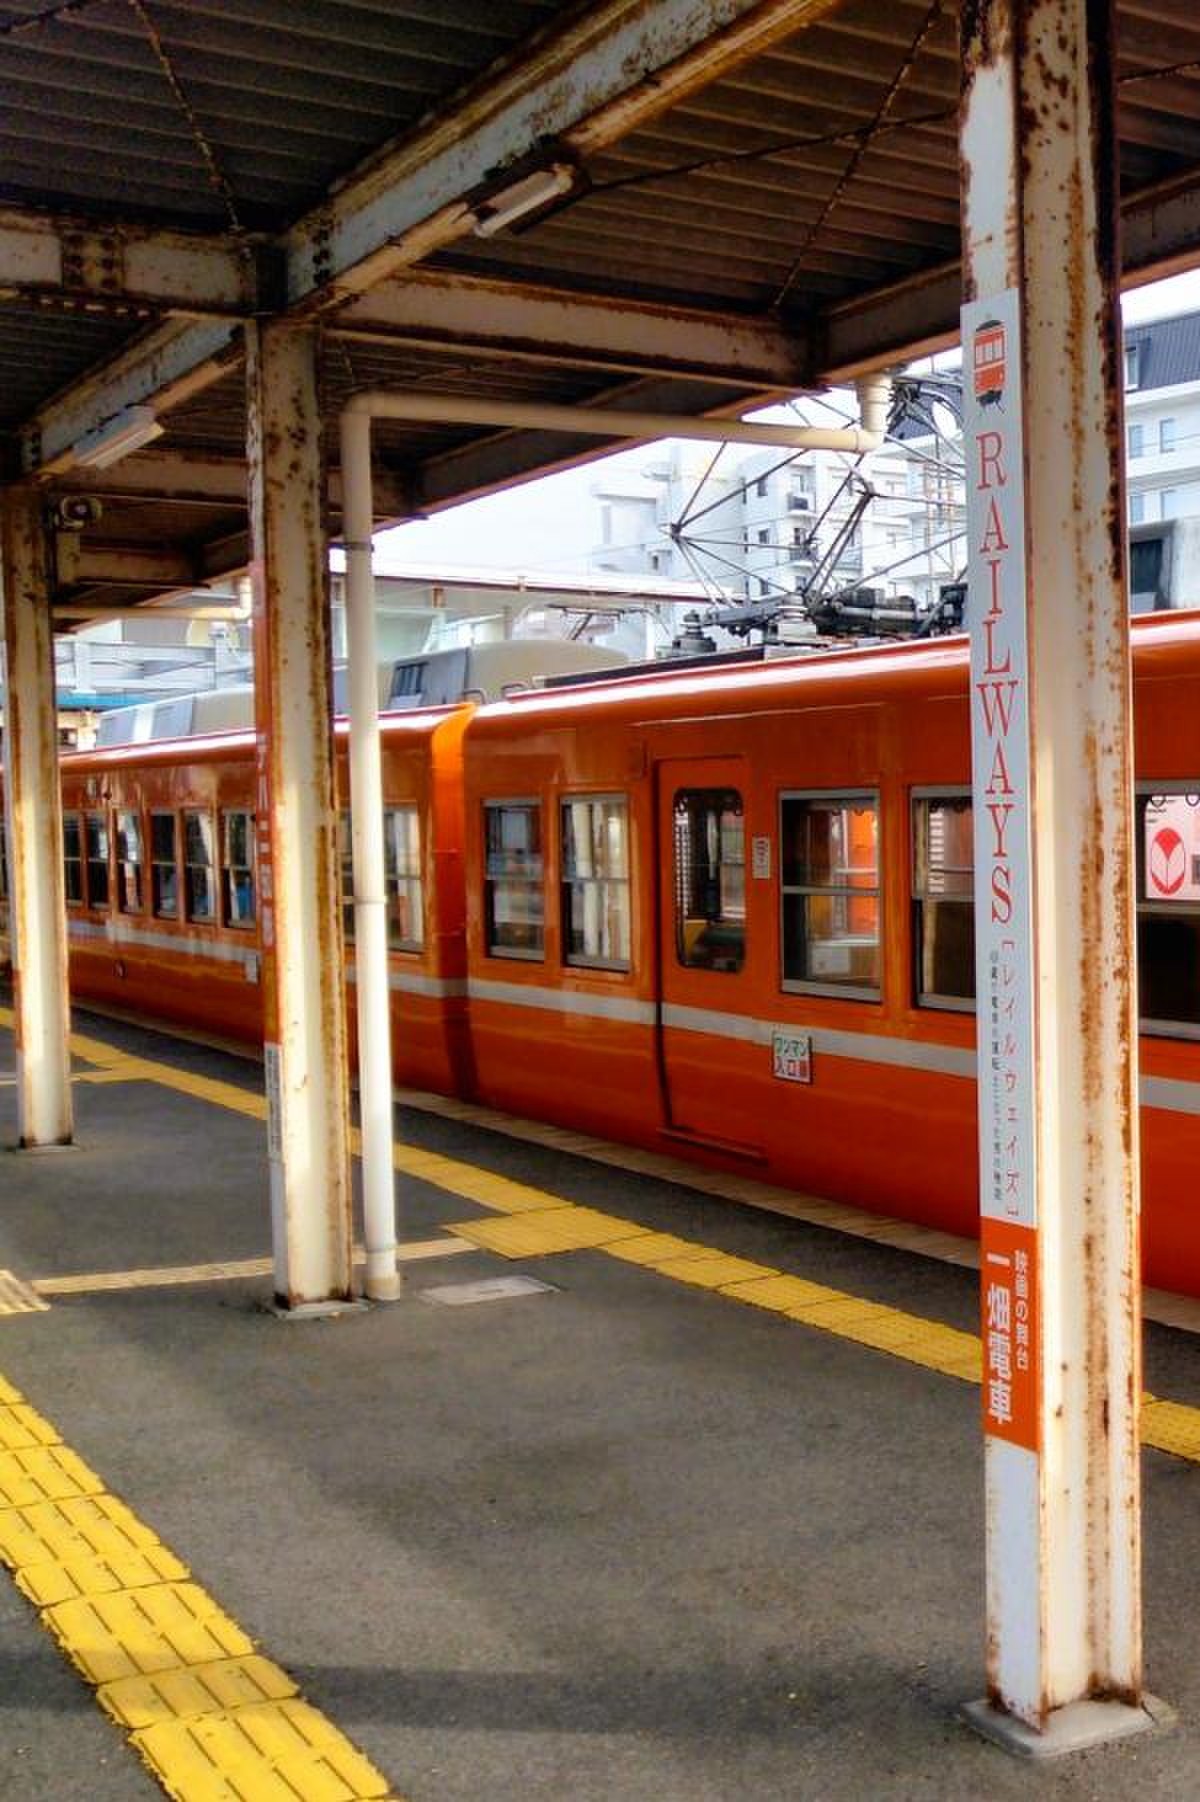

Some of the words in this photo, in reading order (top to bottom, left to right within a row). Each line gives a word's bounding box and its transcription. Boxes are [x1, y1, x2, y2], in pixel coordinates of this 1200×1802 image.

[976, 431, 1019, 925] RAILWAYS
[986, 1252, 1013, 1425] 一畑電車
